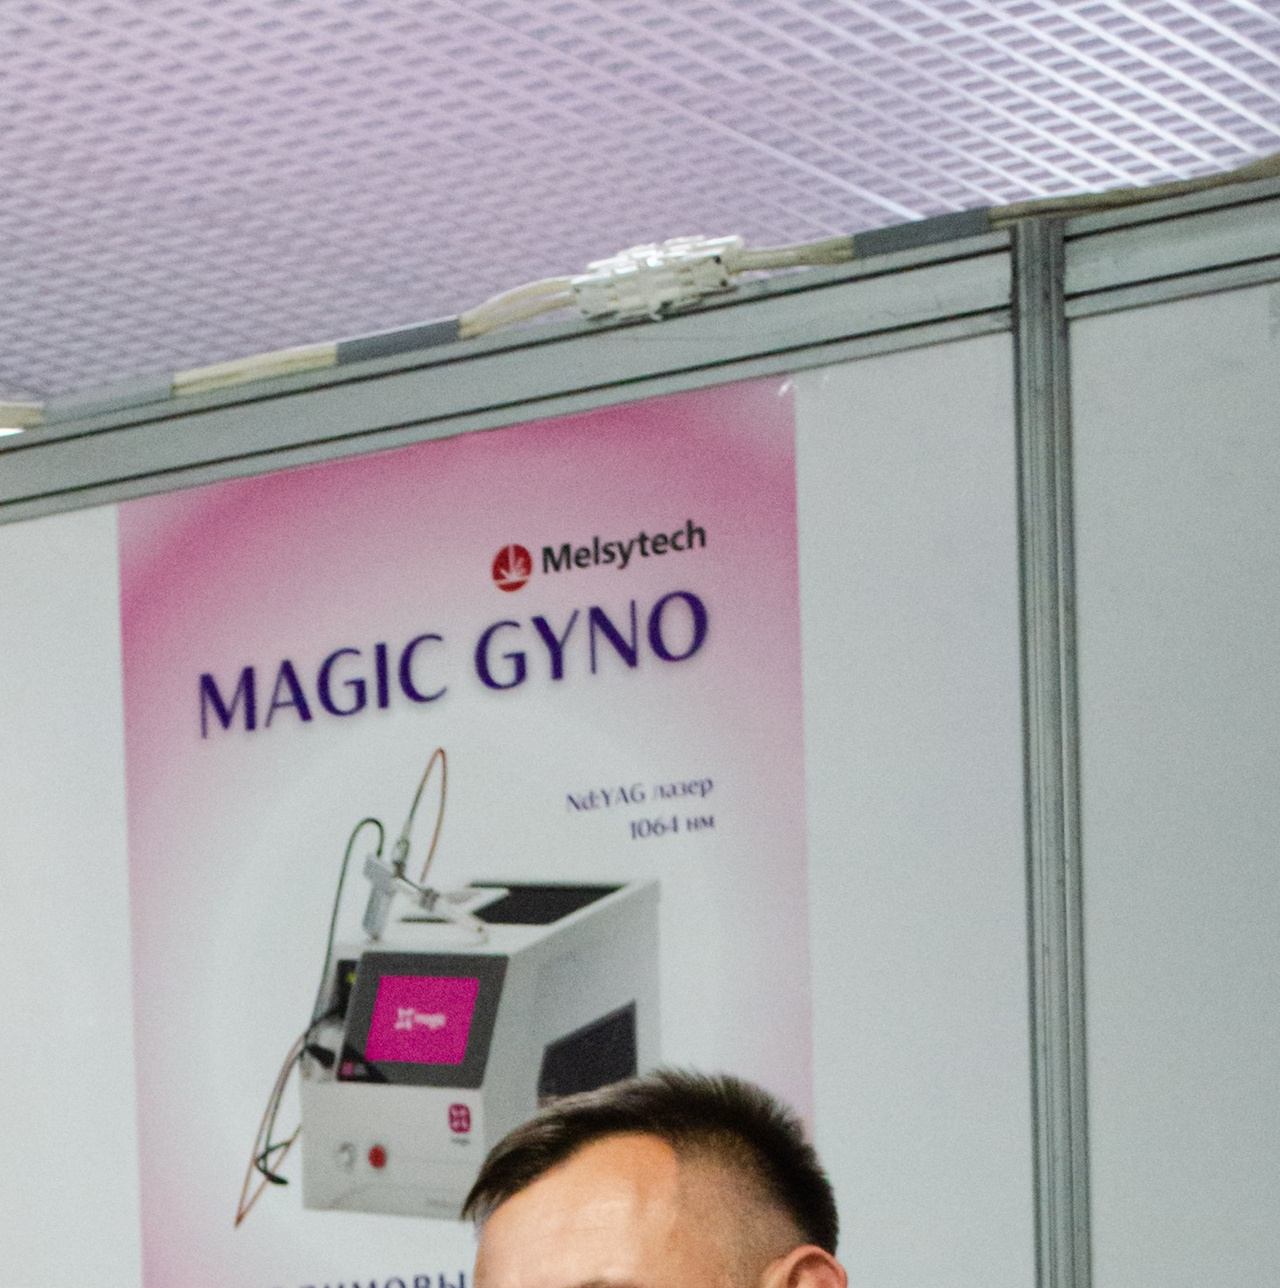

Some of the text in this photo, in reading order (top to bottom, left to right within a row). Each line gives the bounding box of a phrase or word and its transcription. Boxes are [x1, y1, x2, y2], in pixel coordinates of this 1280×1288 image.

[541, 518, 708, 575] Melsytech
[199, 590, 710, 739] MAGIC GYNO
[652, 775, 714, 804] лазер
[630, 818, 679, 840] 1064
